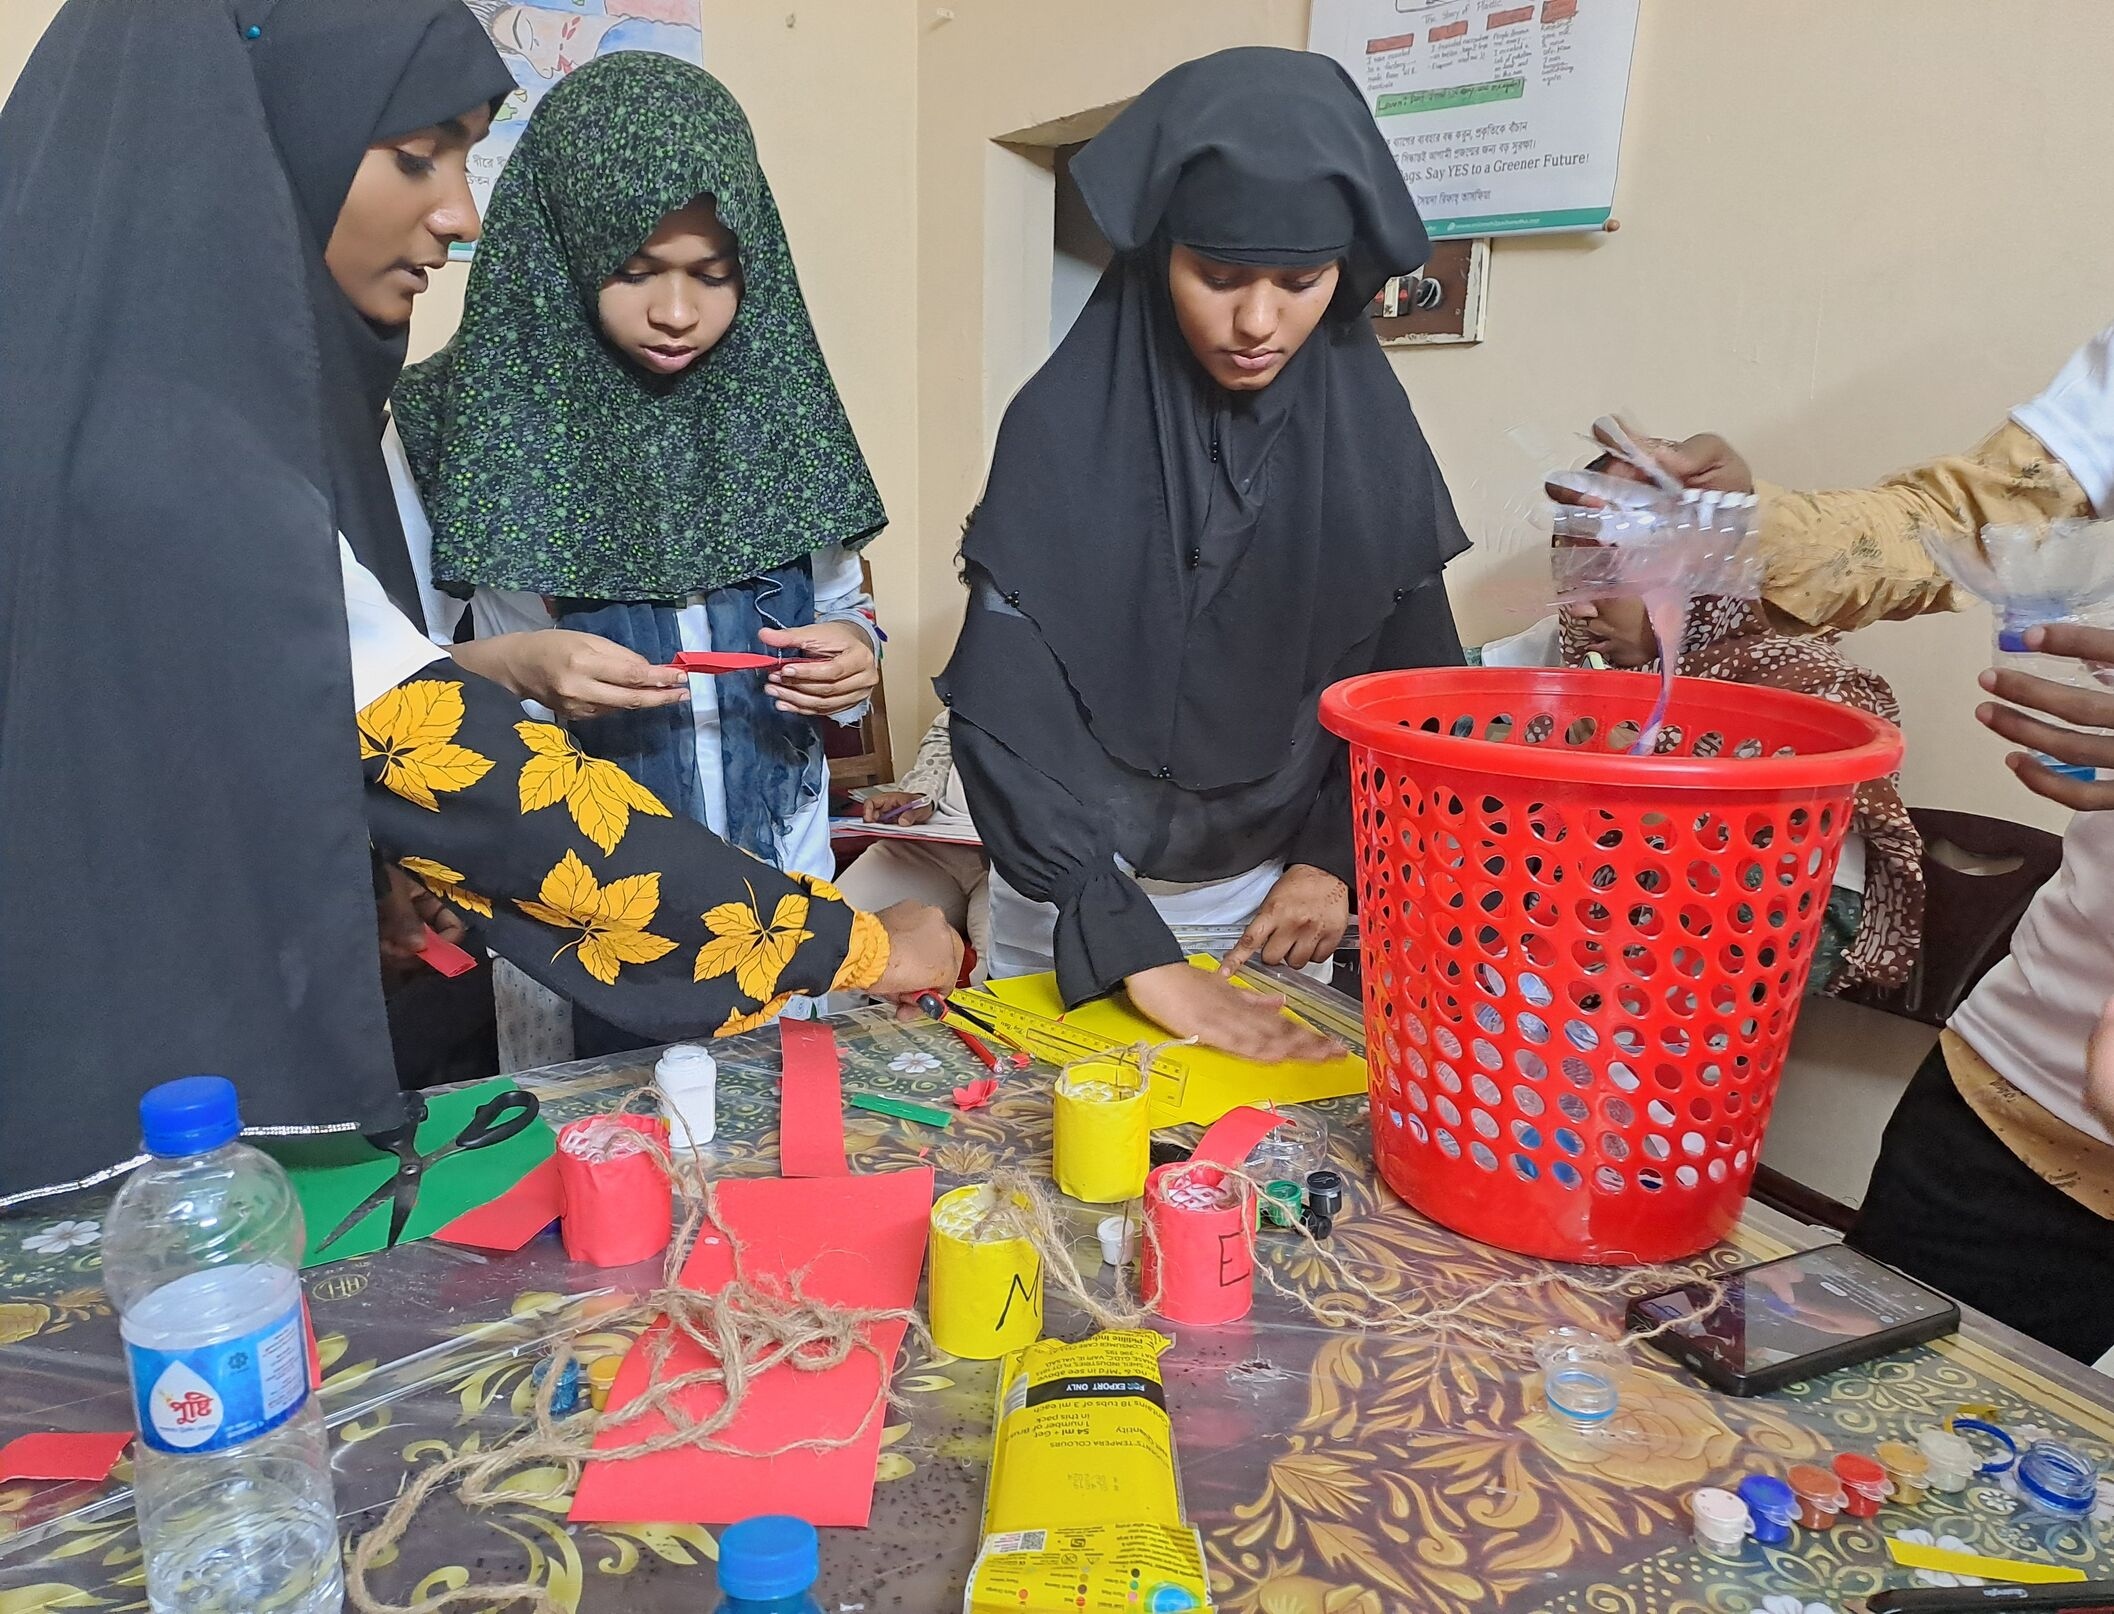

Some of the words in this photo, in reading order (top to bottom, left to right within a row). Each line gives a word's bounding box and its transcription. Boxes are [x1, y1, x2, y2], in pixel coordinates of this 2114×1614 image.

[1426, 168, 1445, 182] Say
[1448, 164, 1469, 177] YES
[1471, 164, 1482, 175] to
[1484, 165, 1490, 174] a
[1493, 159, 1540, 172] Greener
[1543, 154, 1590, 167] Future!
[1219, 1232, 1250, 1288] E
[995, 1264, 1040, 1332] M
[1111, 1334, 1143, 1344] Pidilite
[1036, 1370, 1065, 1382] above
[1065, 1383, 1088, 1392] ONLY
[1092, 1383, 1126, 1391] EXPORT
[1127, 1383, 1145, 1392] FOR
[170, 1391, 214, 1425] পুষ্টি
[1033, 1403, 1057, 1413] each
[1082, 1401, 1093, 1409] of
[1035, 1413, 1058, 1424] pack
[1032, 1423, 1043, 1433] of
[1043, 1420, 1083, 1429] number
[1034, 1430, 1051, 1438] Get
[1061, 1428, 1075, 1436] ml
[1077, 1427, 1090, 1435] 54
[1049, 1440, 1091, 1448] COLOURS
